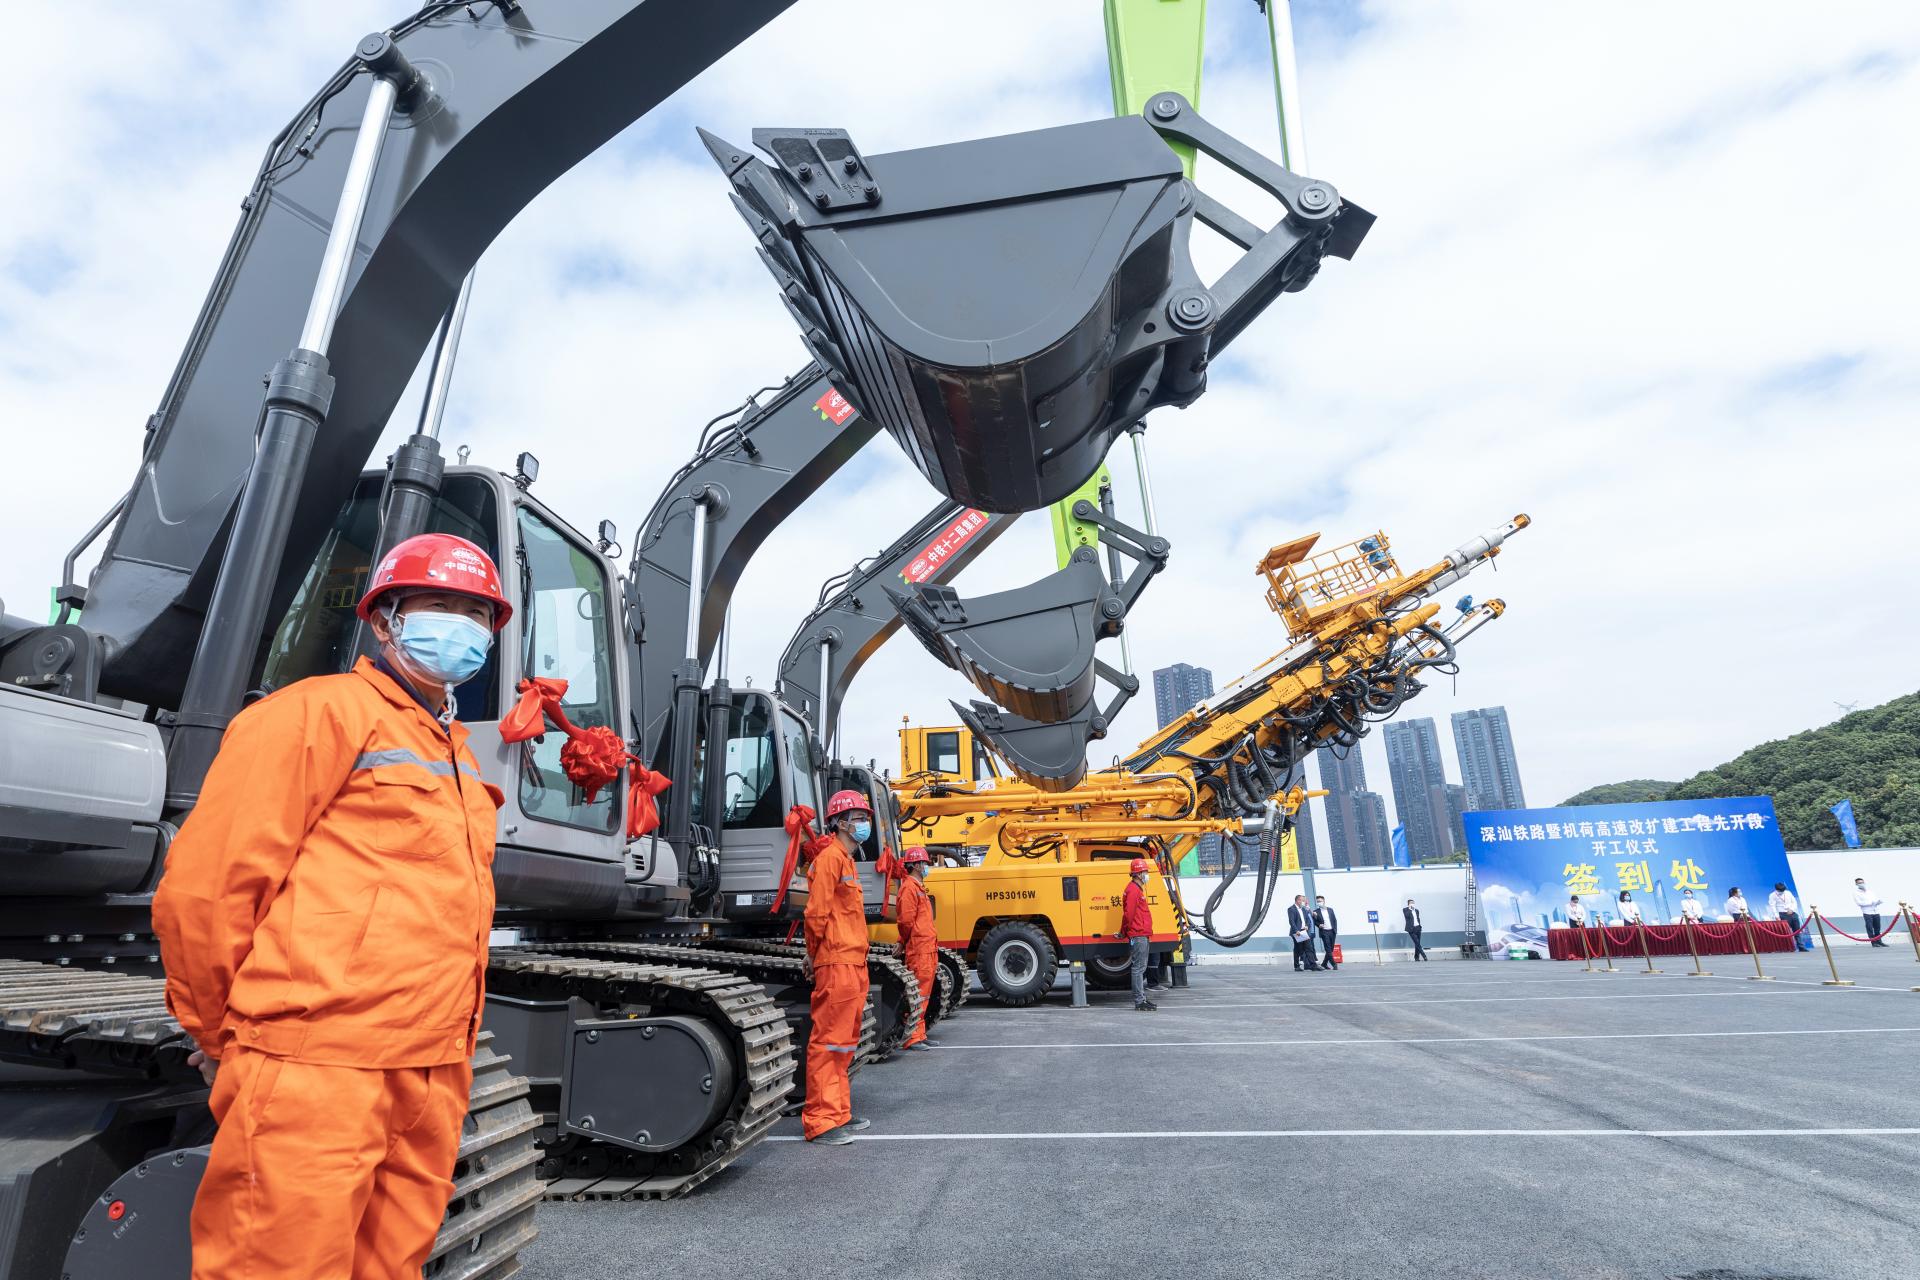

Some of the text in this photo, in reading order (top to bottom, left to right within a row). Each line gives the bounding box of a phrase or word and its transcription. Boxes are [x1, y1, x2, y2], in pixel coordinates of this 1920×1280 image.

[927, 512, 983, 563] 中铁十二局集团
[1480, 812, 1765, 842] 深汕铁路暨机荷高速改扩建工程先开段
[1591, 837, 1660, 857] 开工仪式
[1562, 858, 1709, 896] 签到处
[985, 890, 1036, 901] HPS3016W
[1110, 895, 1158, 908] 铁工
